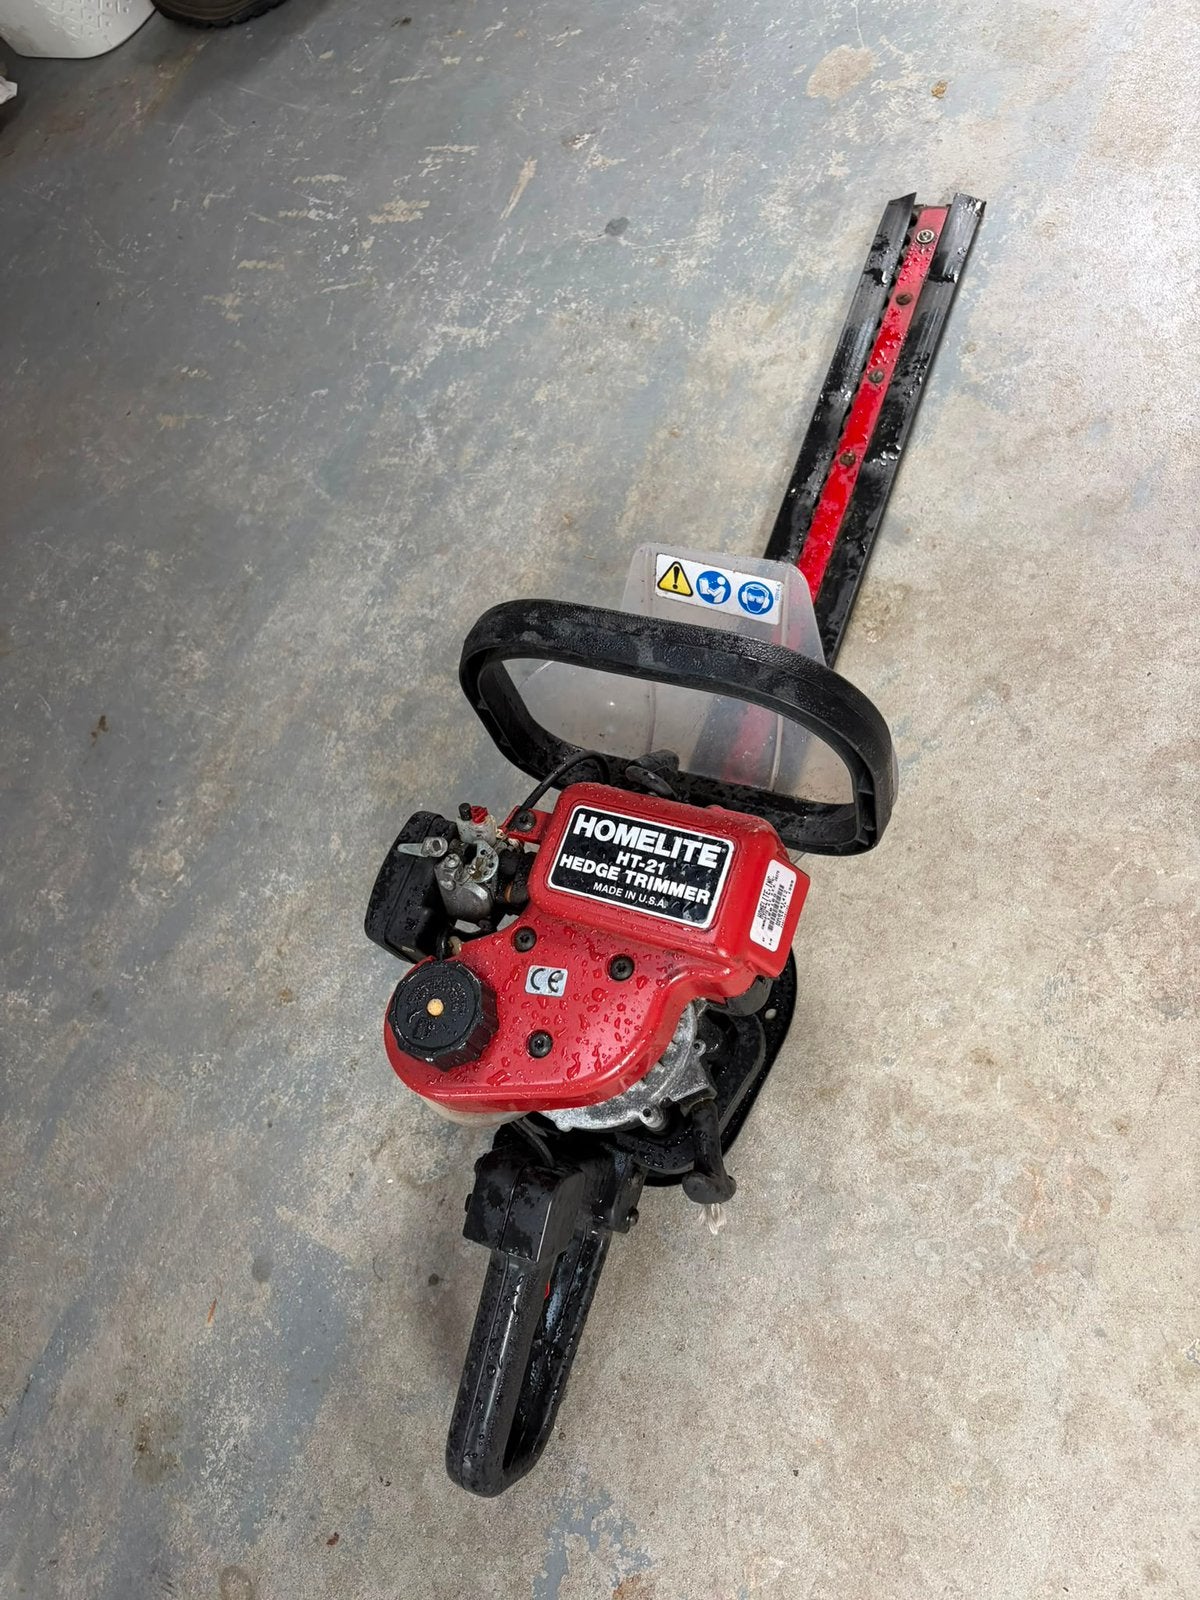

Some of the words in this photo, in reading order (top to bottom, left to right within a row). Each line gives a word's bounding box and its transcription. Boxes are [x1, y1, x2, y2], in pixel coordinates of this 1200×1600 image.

[573, 813, 722, 869] HOMELITE
[615, 851, 666, 876] HT-21
[559, 853, 620, 881] HEDGE
[624, 870, 711, 905] TRIMMER
[593, 882, 624, 897] MADE
[625, 890, 637, 901] IN
[530, 968, 564, 993] CE
